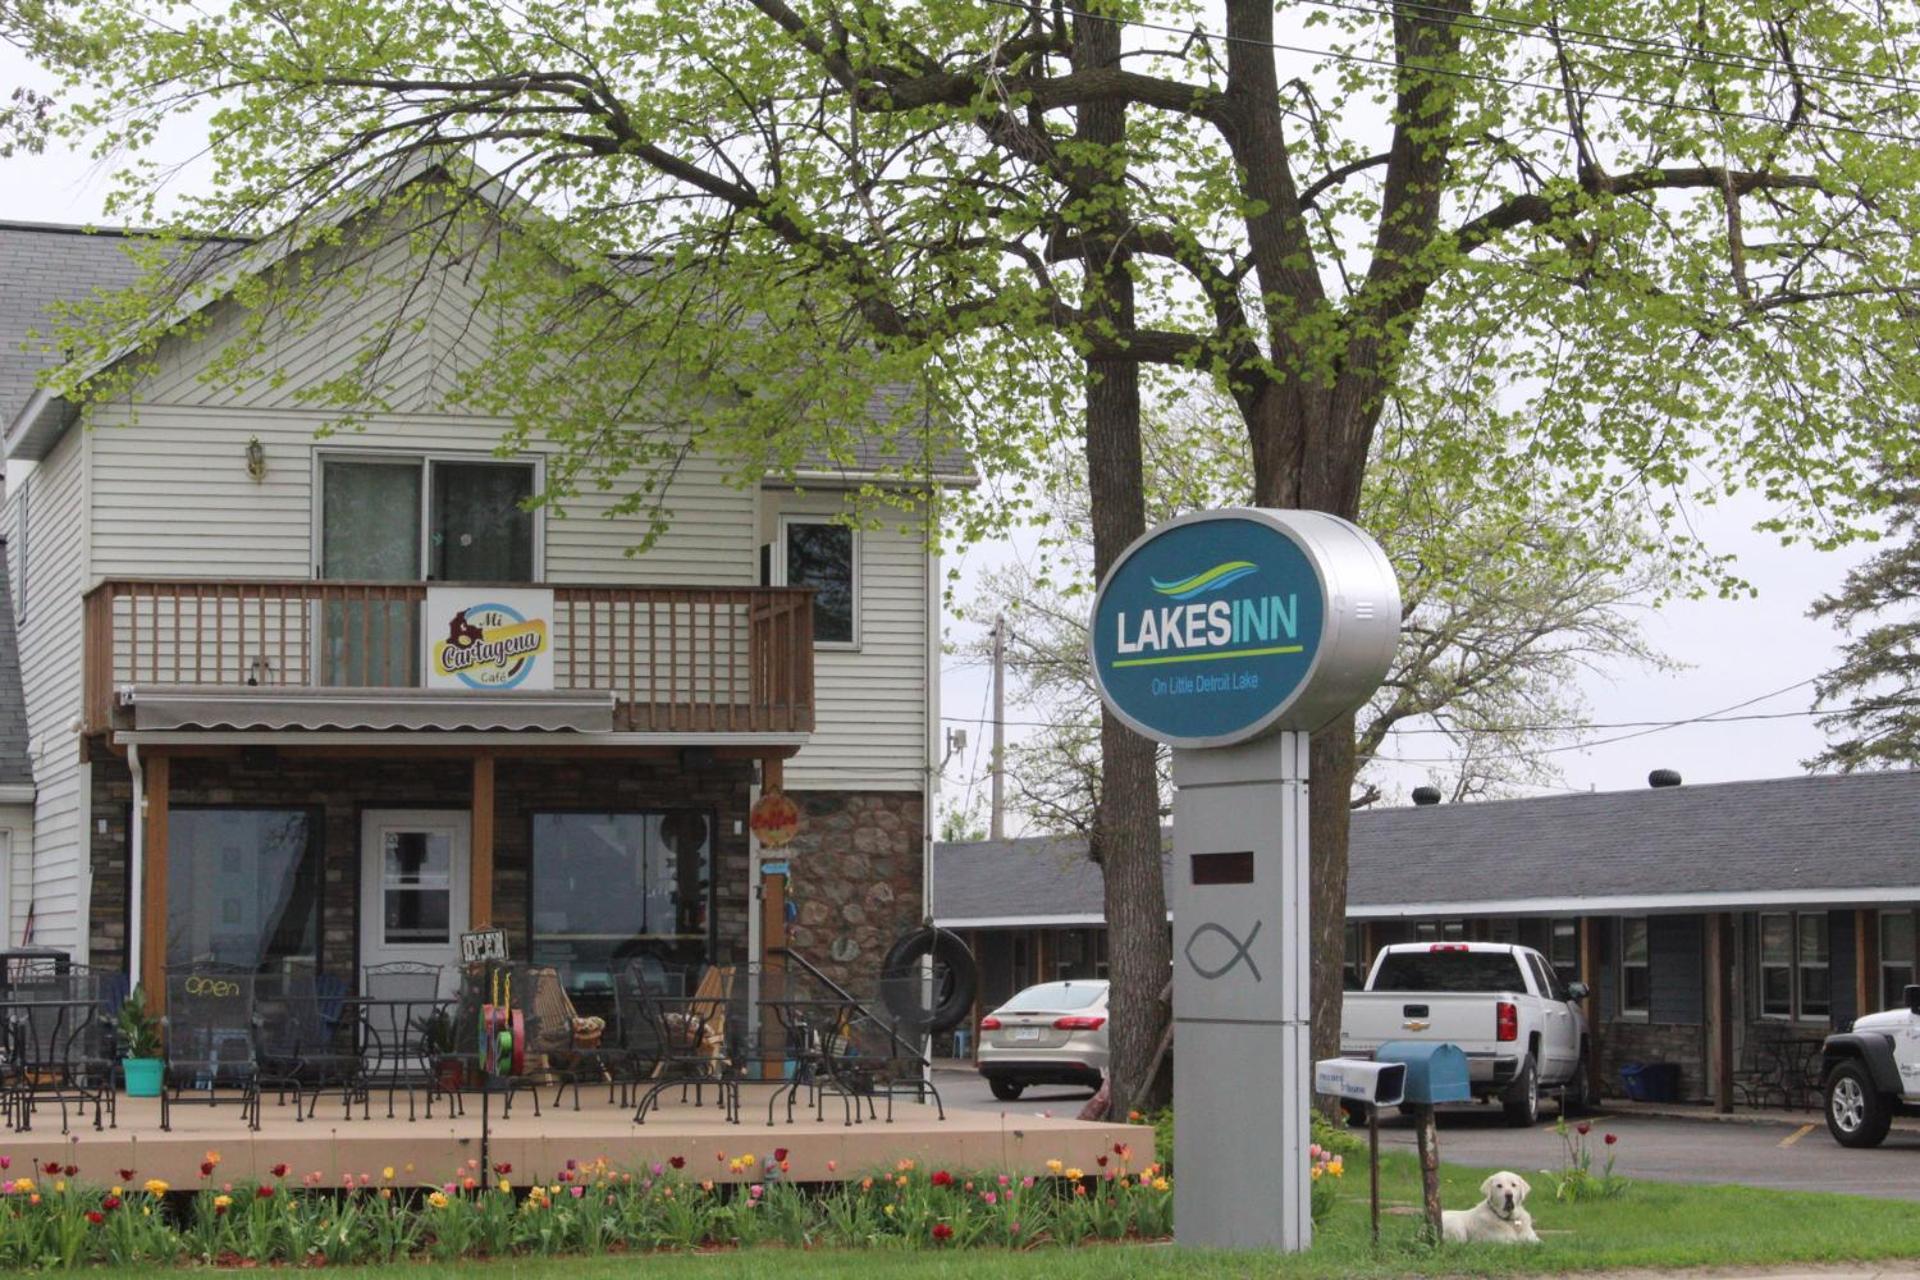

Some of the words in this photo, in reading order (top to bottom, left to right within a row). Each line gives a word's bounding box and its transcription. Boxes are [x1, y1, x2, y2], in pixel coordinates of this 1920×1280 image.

[479, 612, 502, 627] Mi
[442, 632, 541, 672] Cartagena
[1151, 678, 1168, 696] On
[1169, 676, 1194, 695] Little
[1196, 673, 1230, 693] Detroit
[1233, 670, 1258, 690] Lake
